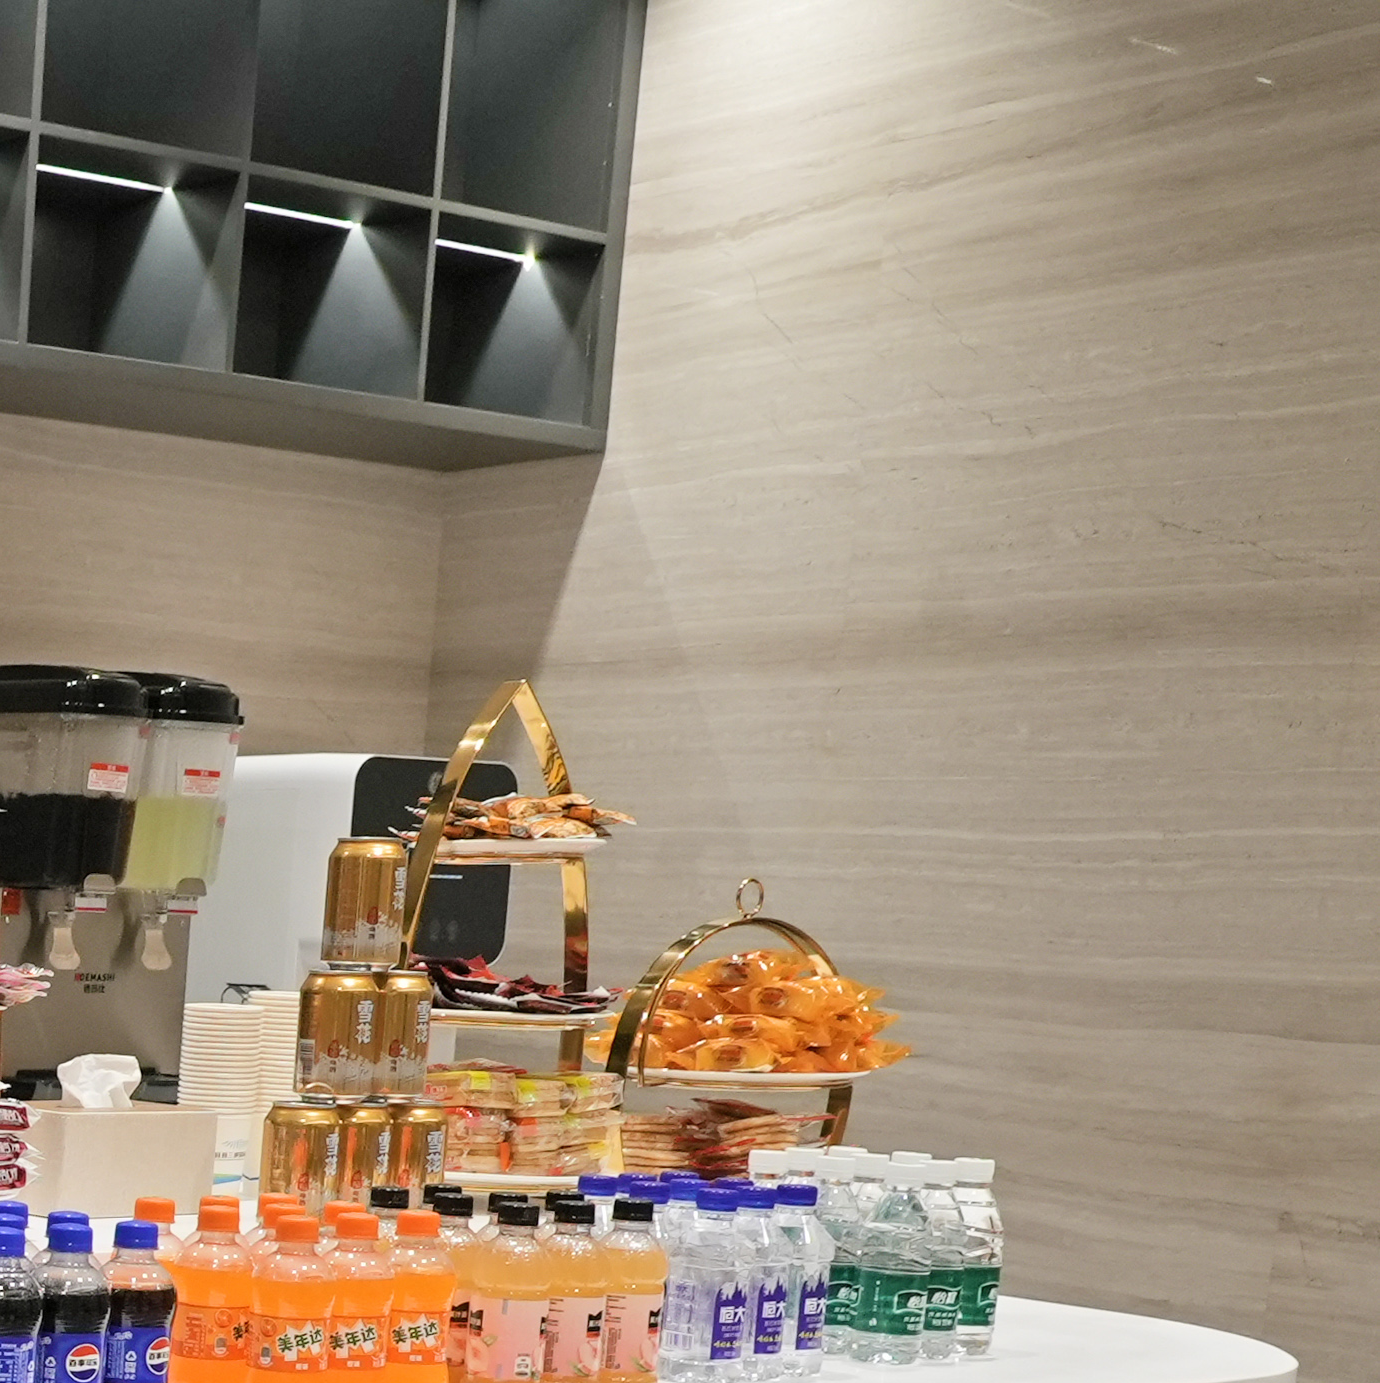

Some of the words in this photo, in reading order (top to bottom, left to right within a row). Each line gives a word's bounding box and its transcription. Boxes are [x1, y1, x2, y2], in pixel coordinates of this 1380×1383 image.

[354, 1000, 374, 1045] 雪花
[426, 1130, 443, 1173] 雪花
[719, 1306, 747, 1324] 恒大
[761, 1301, 787, 1319] 恒大
[277, 1328, 323, 1353] 美年达
[329, 1325, 377, 1351] 美年达
[391, 1321, 439, 1345] 美年达
